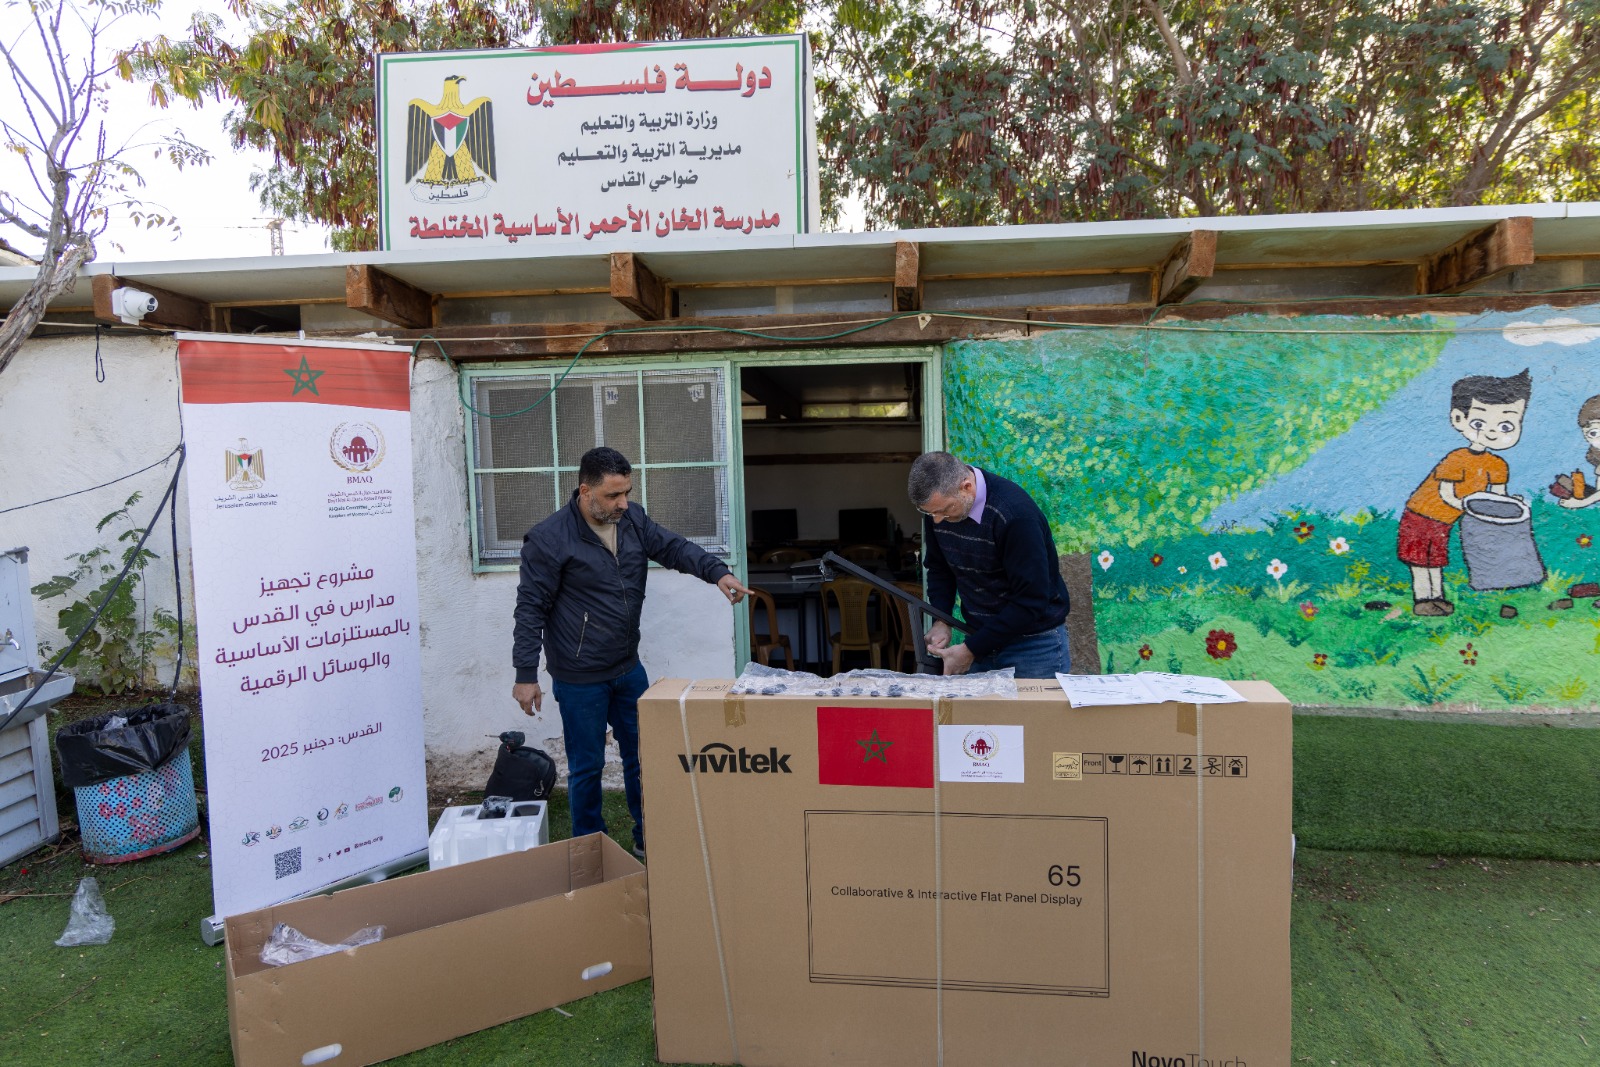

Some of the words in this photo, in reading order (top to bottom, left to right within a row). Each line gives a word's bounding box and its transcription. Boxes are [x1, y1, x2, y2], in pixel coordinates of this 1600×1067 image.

[526, 64, 667, 107] فلسطين
[674, 61, 772, 97] دولة
[580, 114, 635, 135] والتعليم
[638, 111, 682, 132] التربية
[686, 110, 718, 131] وزارة
[557, 144, 628, 166] والتعليم
[631, 142, 676, 162] التربية
[679, 140, 742, 160] مديرية
[600, 170, 645, 192] القدس
[649, 169, 699, 192] ضواحي
[428, 187, 469, 202] فلسطين
[408, 212, 489, 240] المختلطة
[492, 206, 580, 243] الأساسية
[583, 204, 650, 240] الأحمر
[655, 207, 708, 238] الخان
[713, 205, 780, 234] مدرسة
[346, 475, 374, 484] BMAQ
[259, 571, 311, 598] تجهيز
[316, 563, 374, 589] مشروع
[305, 600, 335, 627] في
[340, 593, 395, 617] مدارس
[233, 604, 299, 634] القدس
[305, 618, 410, 649] بالمستلزمات
[215, 635, 299, 667] الأساسية
[312, 651, 390, 682] والوسائل
[240, 665, 307, 695] الرقمية
[261, 742, 299, 762] 2025
[302, 737, 335, 755] دجنبر
[677, 742, 793, 773] vivitek
[1083, 759, 1102, 767] Front
[1183, 757, 1192, 770] 2
[1047, 864, 1082, 887] 65
[831, 885, 904, 899] Collaborative
[906, 888, 915, 899] &
[917, 888, 978, 902] Interactive
[980, 891, 1002, 903] Flat
[1005, 892, 1037, 903] Panel
[1040, 893, 1083, 907] Display
